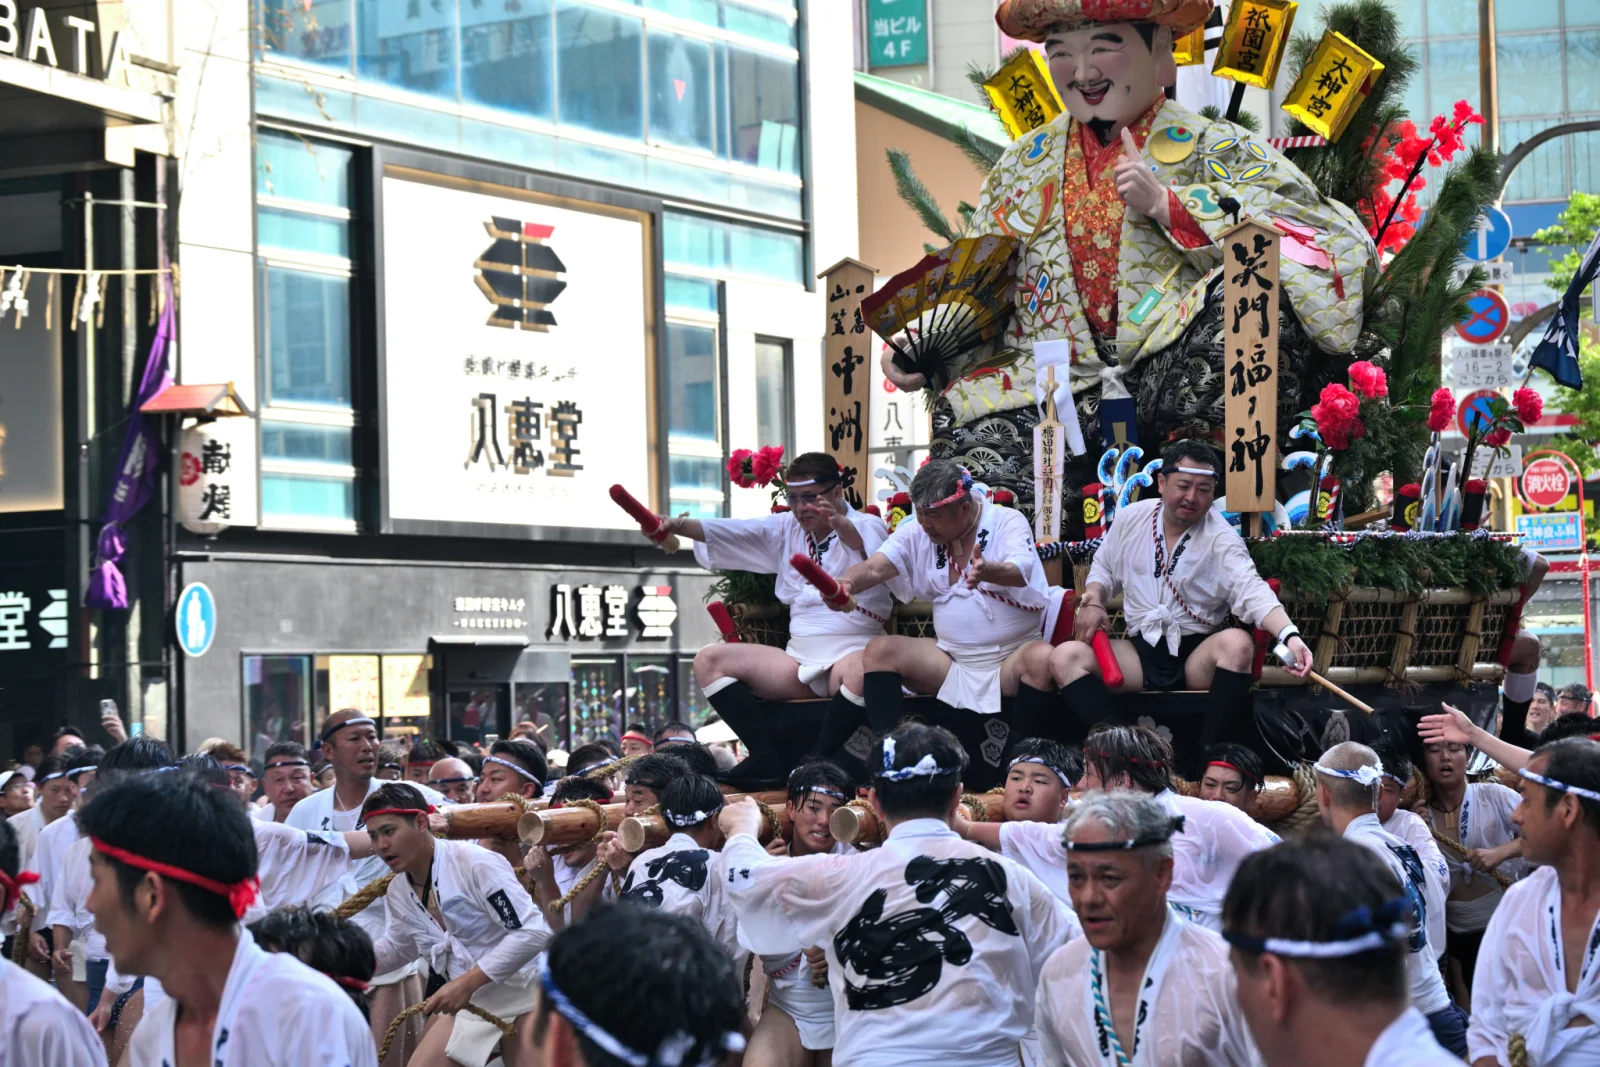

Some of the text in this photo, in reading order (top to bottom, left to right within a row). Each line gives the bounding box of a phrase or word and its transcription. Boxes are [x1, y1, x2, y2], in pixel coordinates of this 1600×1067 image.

[874, 16, 922, 37] 当ビル
[1008, 74, 1046, 129] 大神宮
[1307, 56, 1353, 118] 大神宮
[1459, 374, 1508, 386] ここから
[470, 392, 585, 473] 八恵堂
[1527, 473, 1565, 494] 消火栓
[0, 591, 31, 650] 堂
[552, 584, 629, 637] 八恵堂
